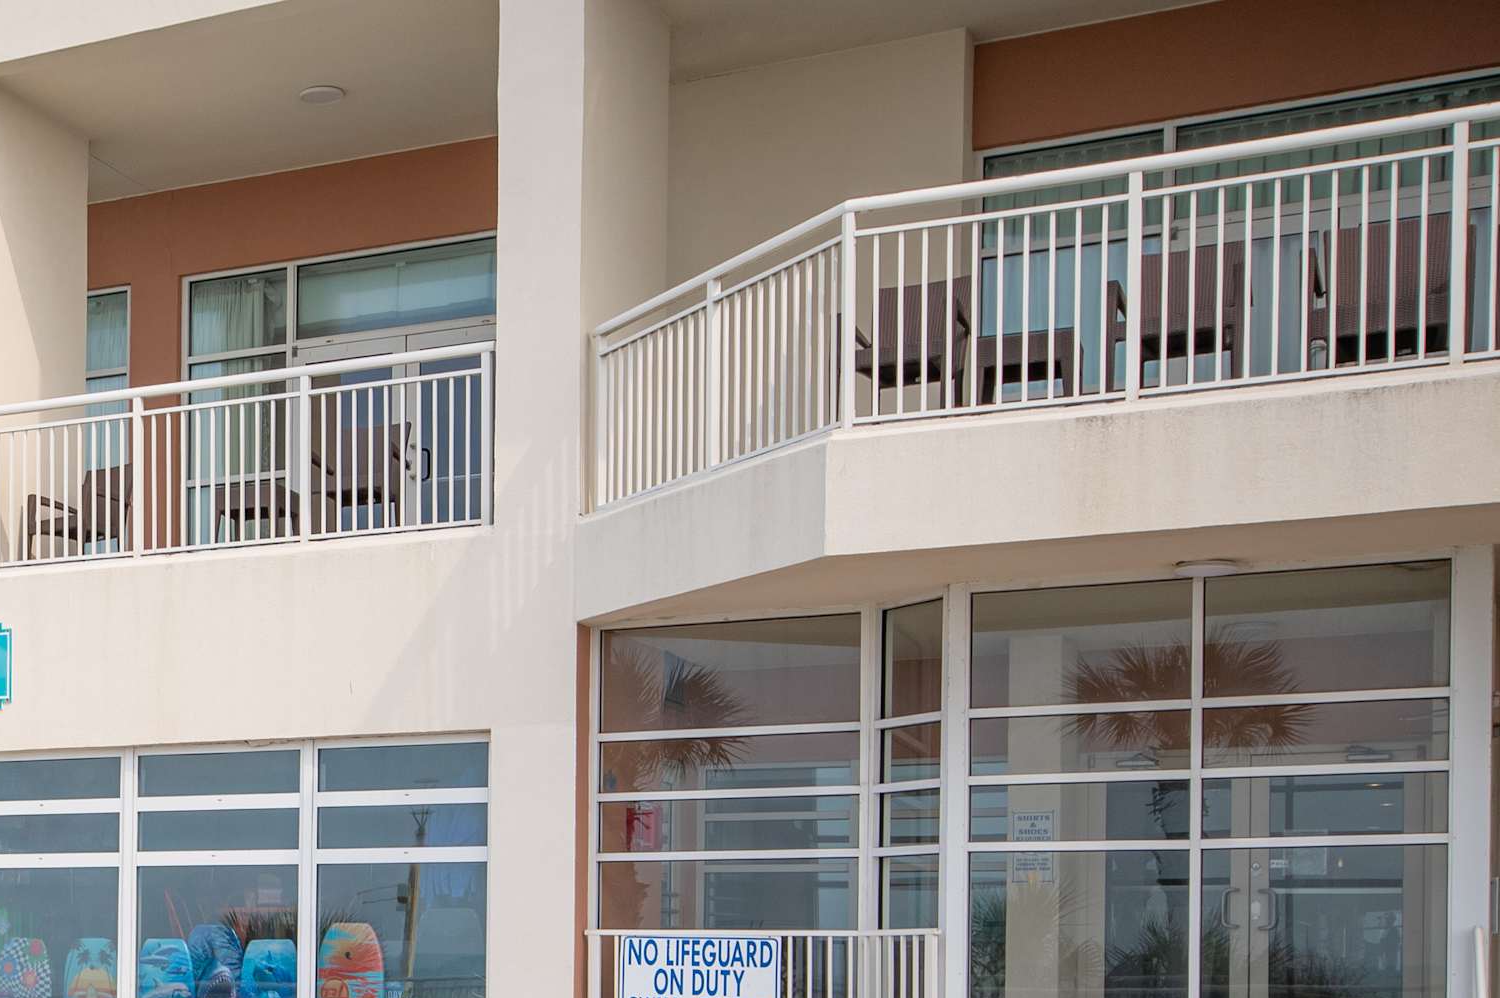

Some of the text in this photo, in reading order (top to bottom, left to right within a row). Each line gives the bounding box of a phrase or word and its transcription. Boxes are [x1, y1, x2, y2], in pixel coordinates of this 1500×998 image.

[628, 939, 773, 968] NO LIFEGUARD
[654, 968, 745, 997] ON DUTY
